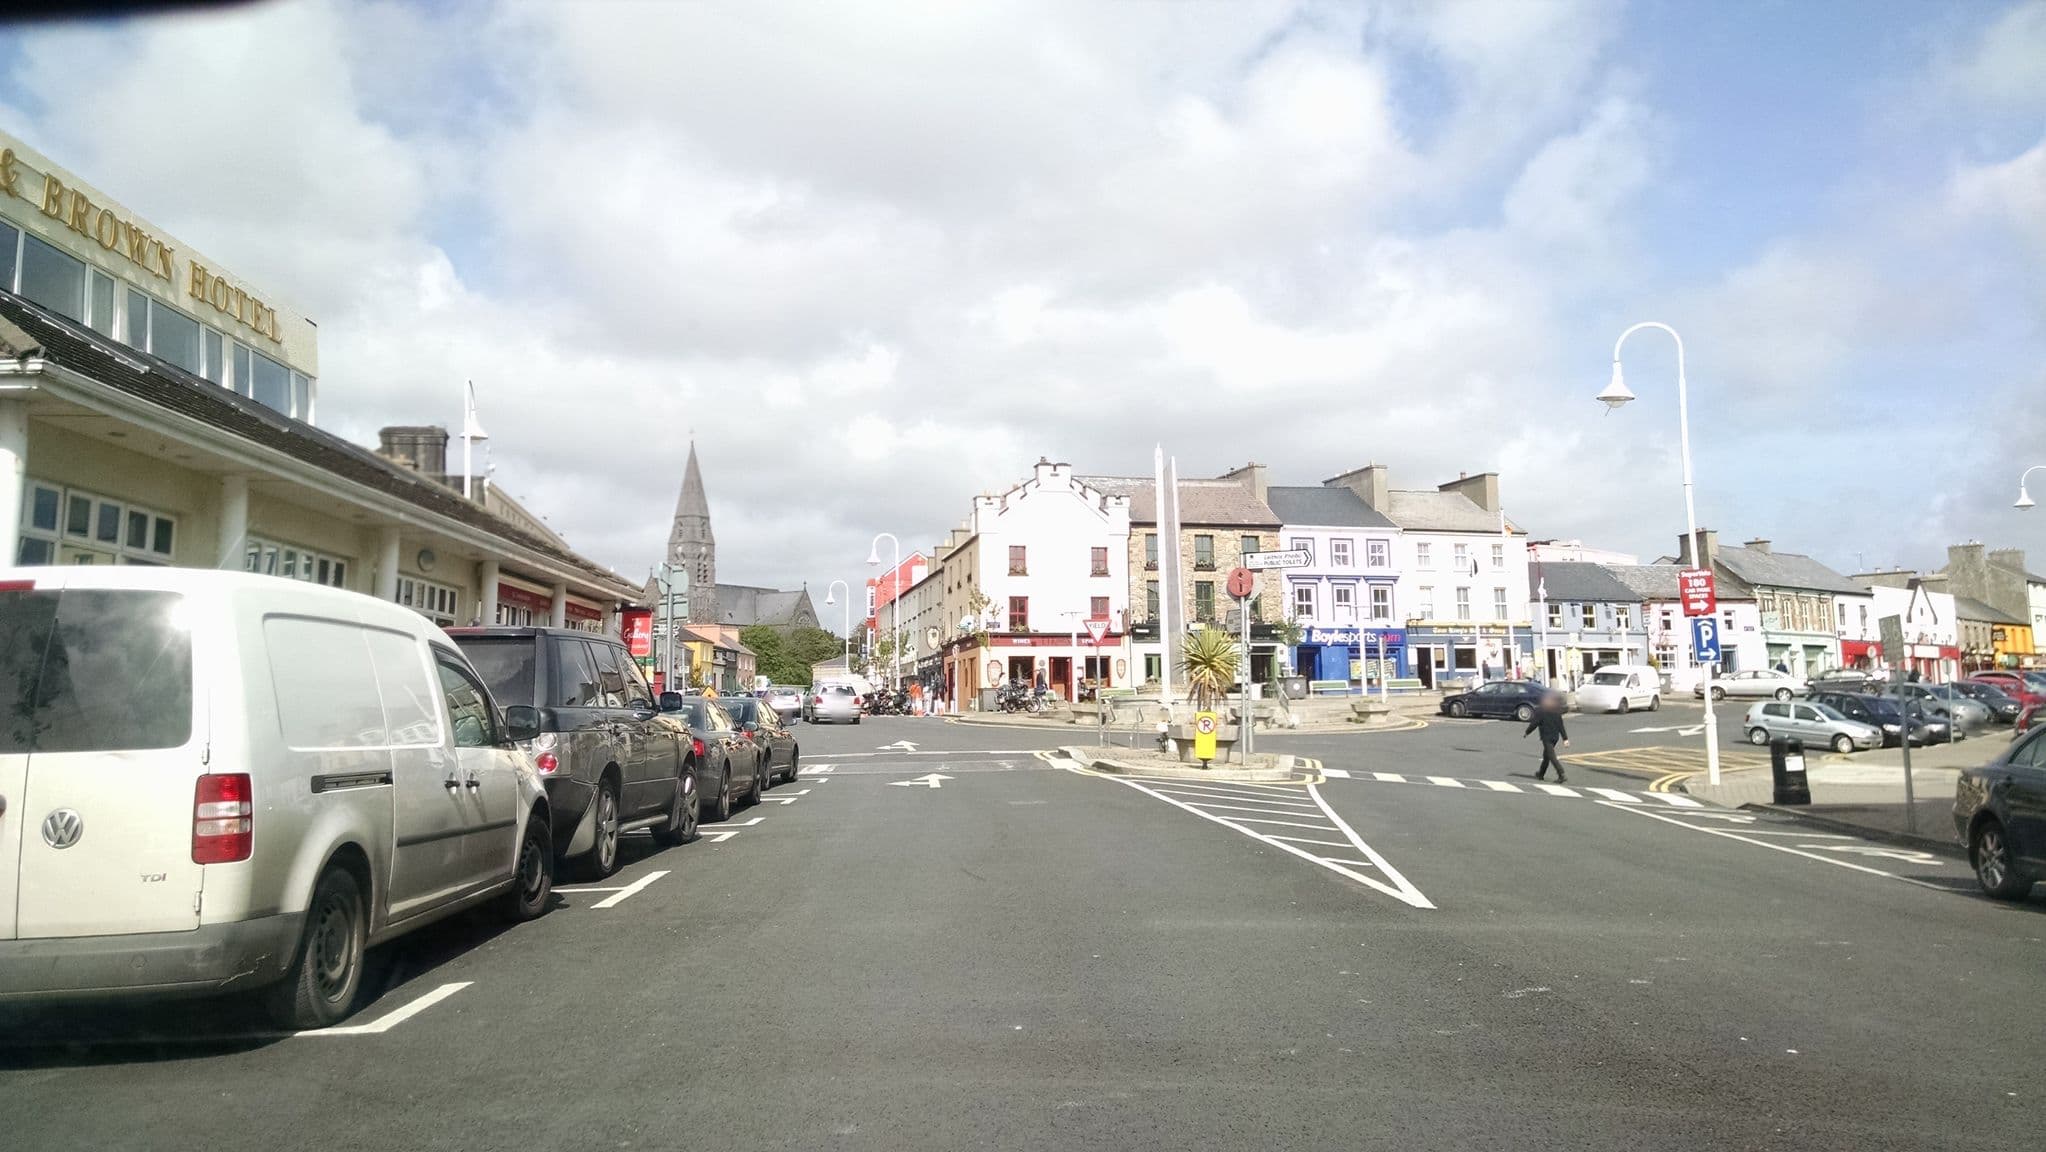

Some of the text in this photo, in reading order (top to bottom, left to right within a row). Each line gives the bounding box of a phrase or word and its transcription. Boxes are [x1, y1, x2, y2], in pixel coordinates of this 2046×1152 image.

[0, 148, 283, 345] & BROWN HOTEL
[1688, 578, 1706, 587] 180
[1312, 629, 1377, 646] Boylesports
[1701, 625, 1713, 648] P
[141, 872, 167, 882] TDI
